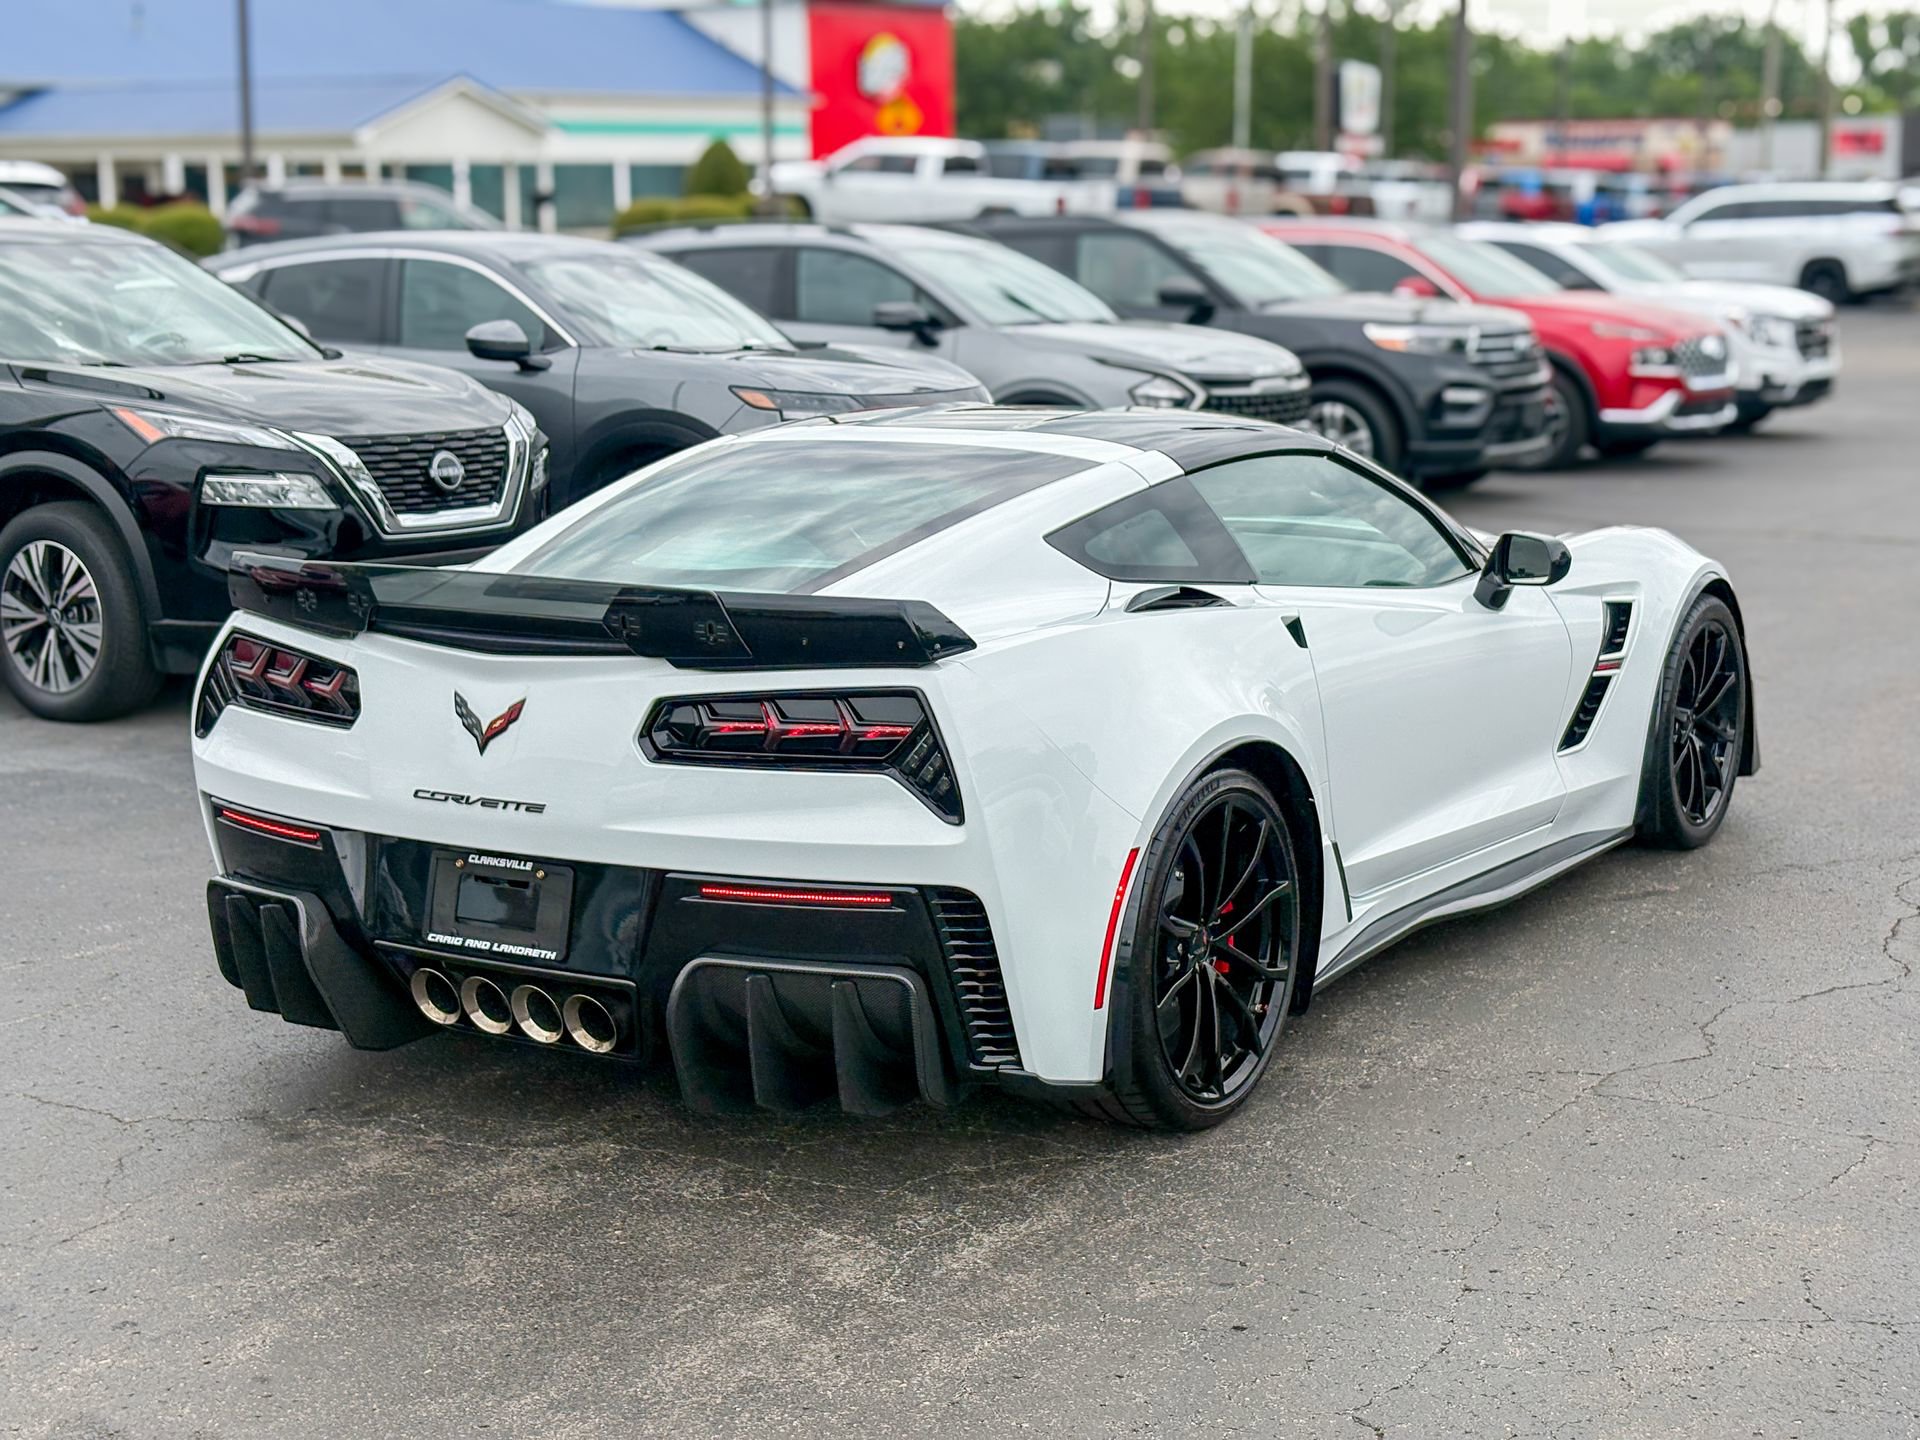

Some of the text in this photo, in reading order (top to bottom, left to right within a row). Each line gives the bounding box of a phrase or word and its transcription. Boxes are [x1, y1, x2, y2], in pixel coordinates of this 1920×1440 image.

[413, 789, 546, 813] CORVETTE
[468, 854, 533, 871] CLARKSVILLE
[427, 933, 557, 960] CRAIG AND LANDRETH
